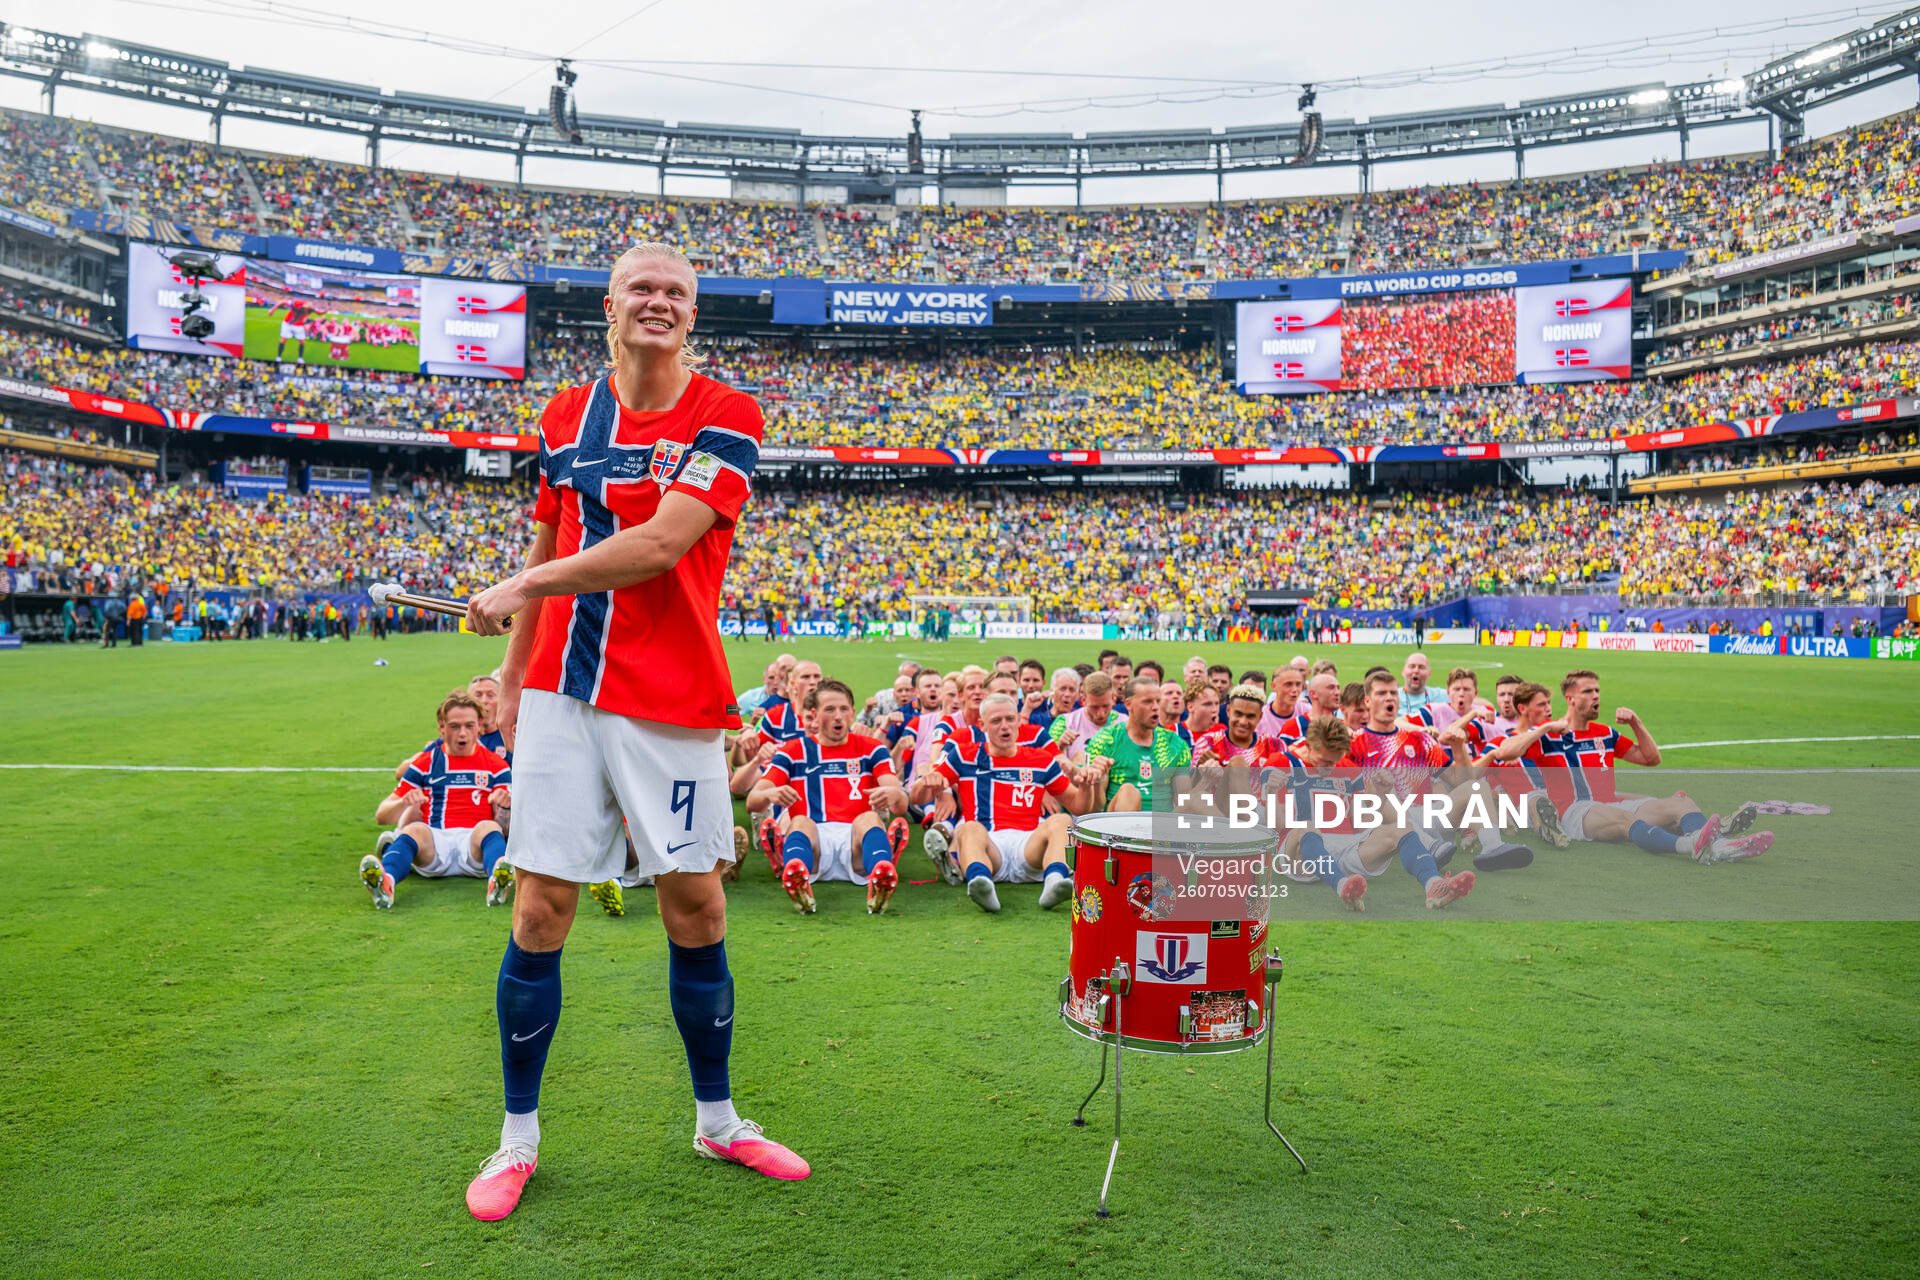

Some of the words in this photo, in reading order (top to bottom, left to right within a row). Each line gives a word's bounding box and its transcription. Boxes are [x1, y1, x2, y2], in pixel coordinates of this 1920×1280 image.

[1341, 281, 1374, 295] FIFA
[1375, 276, 1429, 292] WORLD
[1430, 274, 1462, 289] CUP
[1463, 271, 1518, 287] 2026
[833, 290, 900, 308] NEW
[906, 292, 988, 309] YORK
[833, 309, 889, 323] NEW
[891, 311, 988, 325] JERSEY
[445, 319, 500, 339] NORWAY
[1542, 321, 1603, 342] NORWAY
[1262, 338, 1317, 356] NORWAY
[343, 427, 364, 438] FIFA
[364, 429, 398, 440] WORLD
[398, 431, 417, 441] CUP
[1114, 453, 1133, 461] FIFA
[1133, 453, 1164, 461] WORLD
[1165, 453, 1183, 461] CUP
[1515, 445, 1536, 454] FIFA
[1537, 443, 1572, 453] WORLD
[1573, 442, 1592, 452] CUP
[792, 620, 844, 635] ULTR
[1600, 633, 1636, 651] verizon
[1653, 634, 1695, 653] verizon
[1724, 634, 1777, 656] Michelob
[1791, 637, 1849, 657] ULTRA
[848, 776, 863, 800] 8
[1011, 784, 1036, 808] 26
[670, 780, 697, 831] 9
